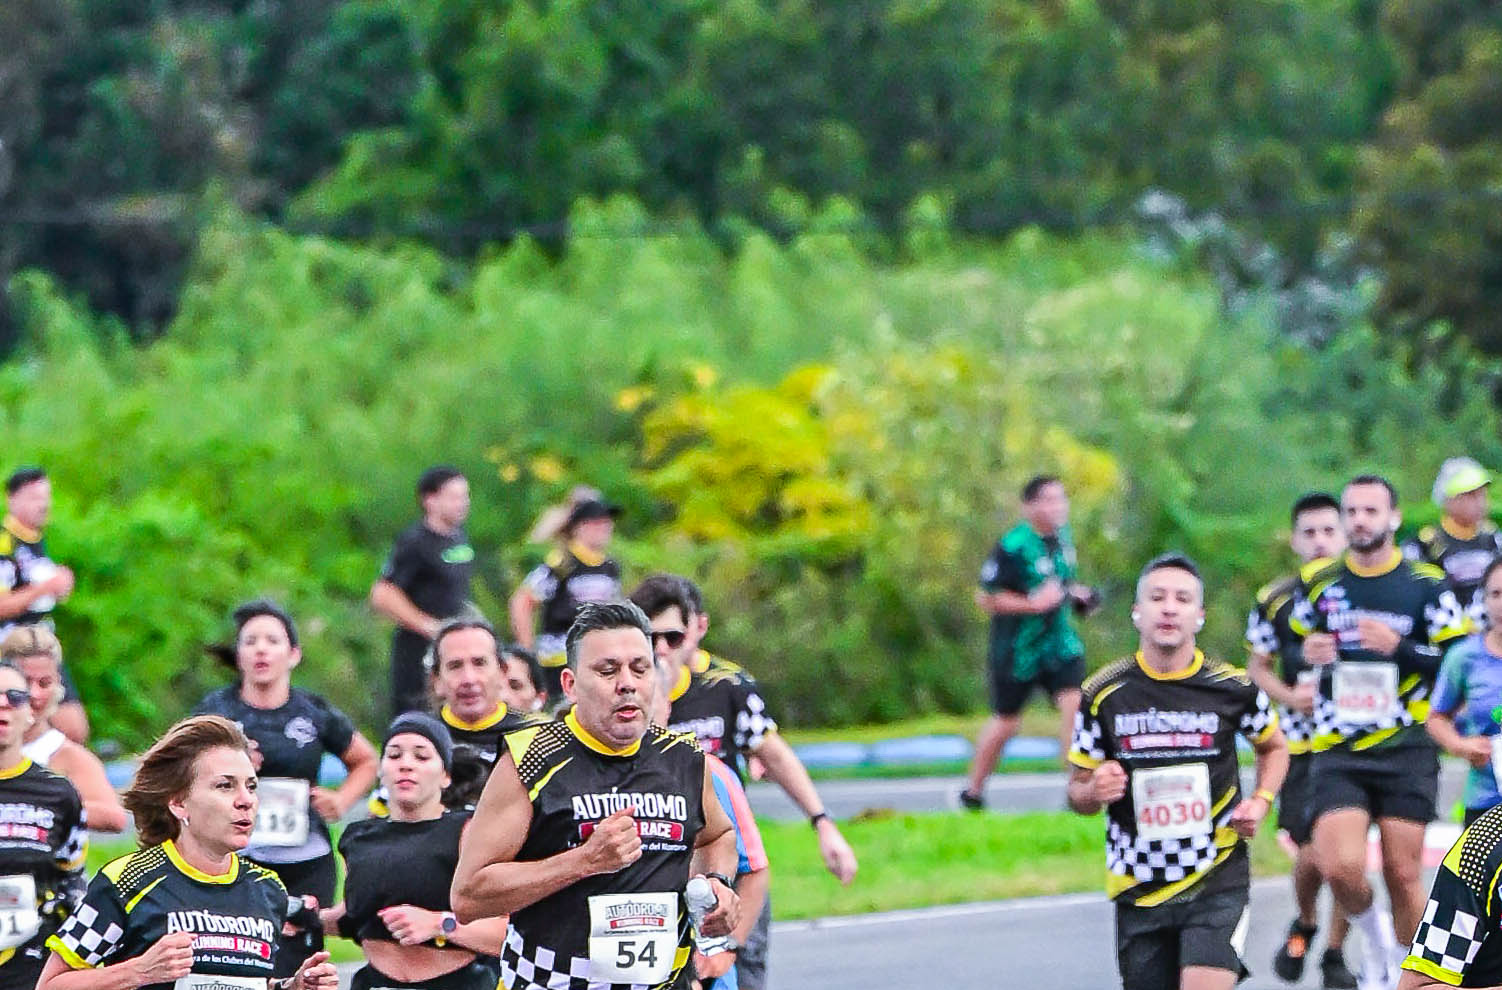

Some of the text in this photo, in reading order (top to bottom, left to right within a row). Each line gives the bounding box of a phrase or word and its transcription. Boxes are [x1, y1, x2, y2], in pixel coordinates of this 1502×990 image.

[1140, 800, 1206, 827] 4030
[640, 821, 672, 838] RACE
[167, 909, 275, 942] AUTÓDROMO
[616, 940, 658, 968] 54
